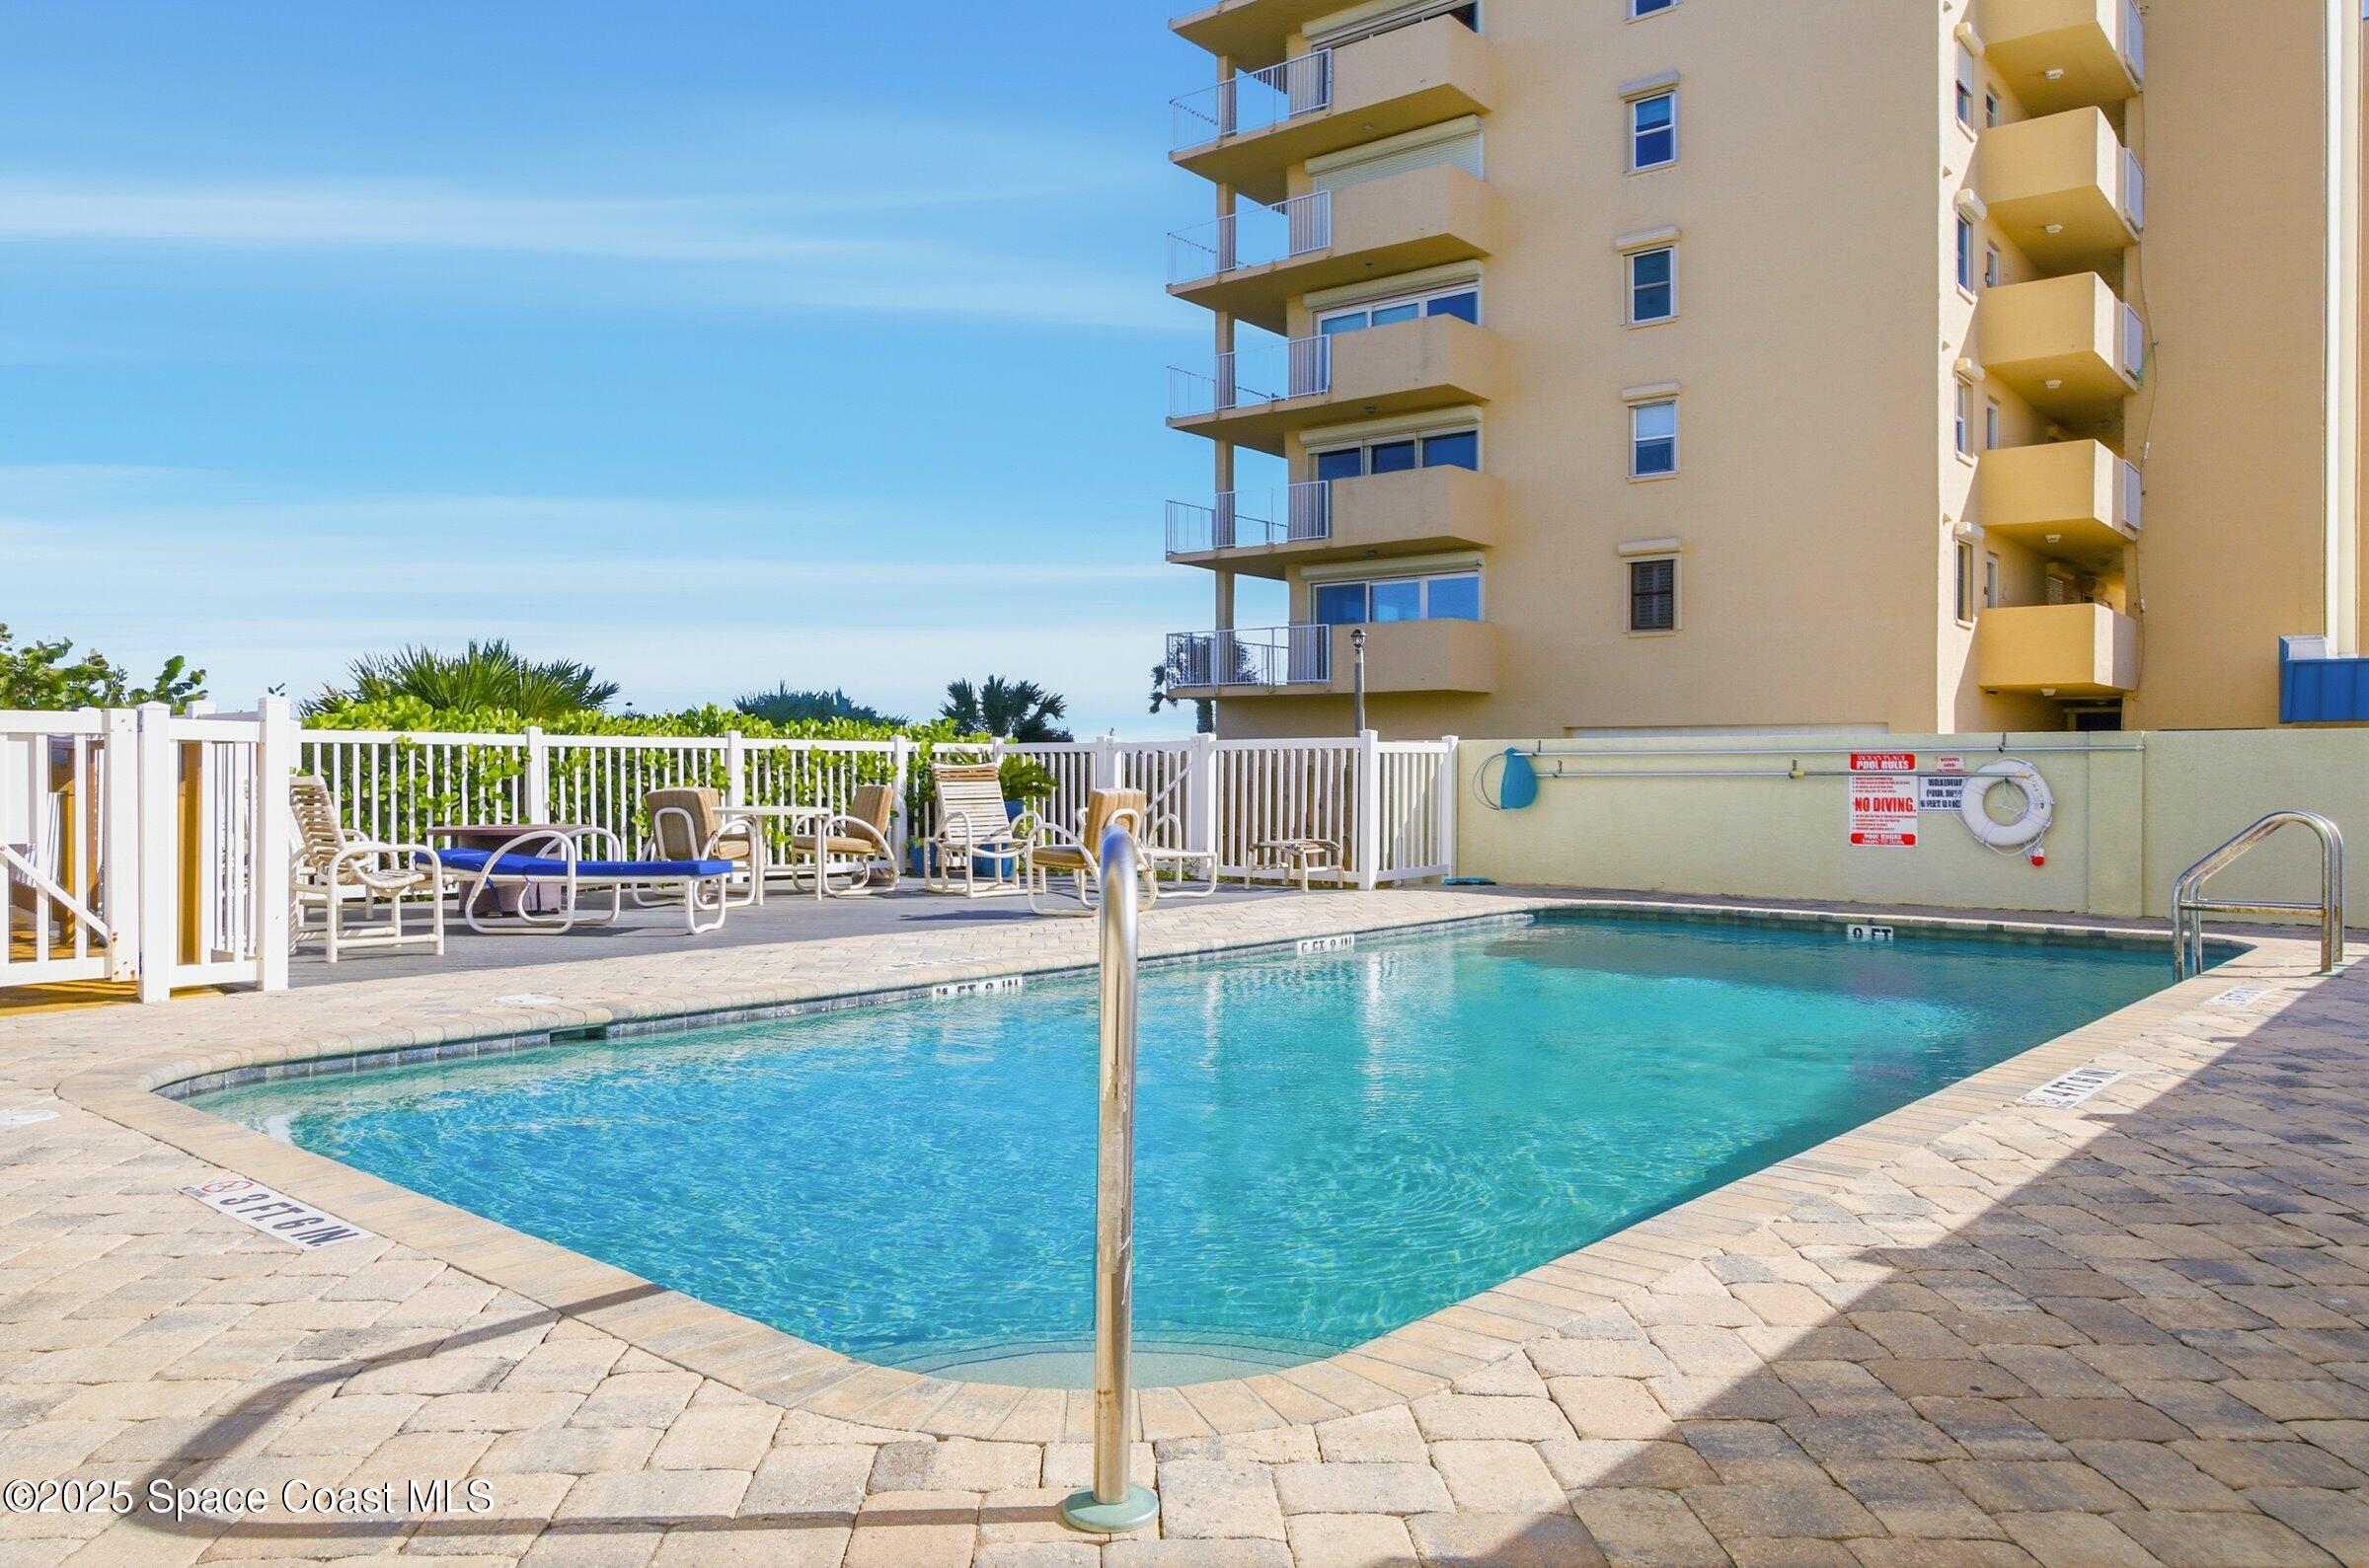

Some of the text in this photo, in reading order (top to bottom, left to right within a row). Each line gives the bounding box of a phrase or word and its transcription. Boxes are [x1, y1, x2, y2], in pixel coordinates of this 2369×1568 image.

[1856, 760, 1910, 770] POOL RULES
[1855, 796, 1870, 812] NO
[1871, 928, 1892, 941] FT
[219, 1193, 270, 1206] 3
[271, 1217, 326, 1231] 6
